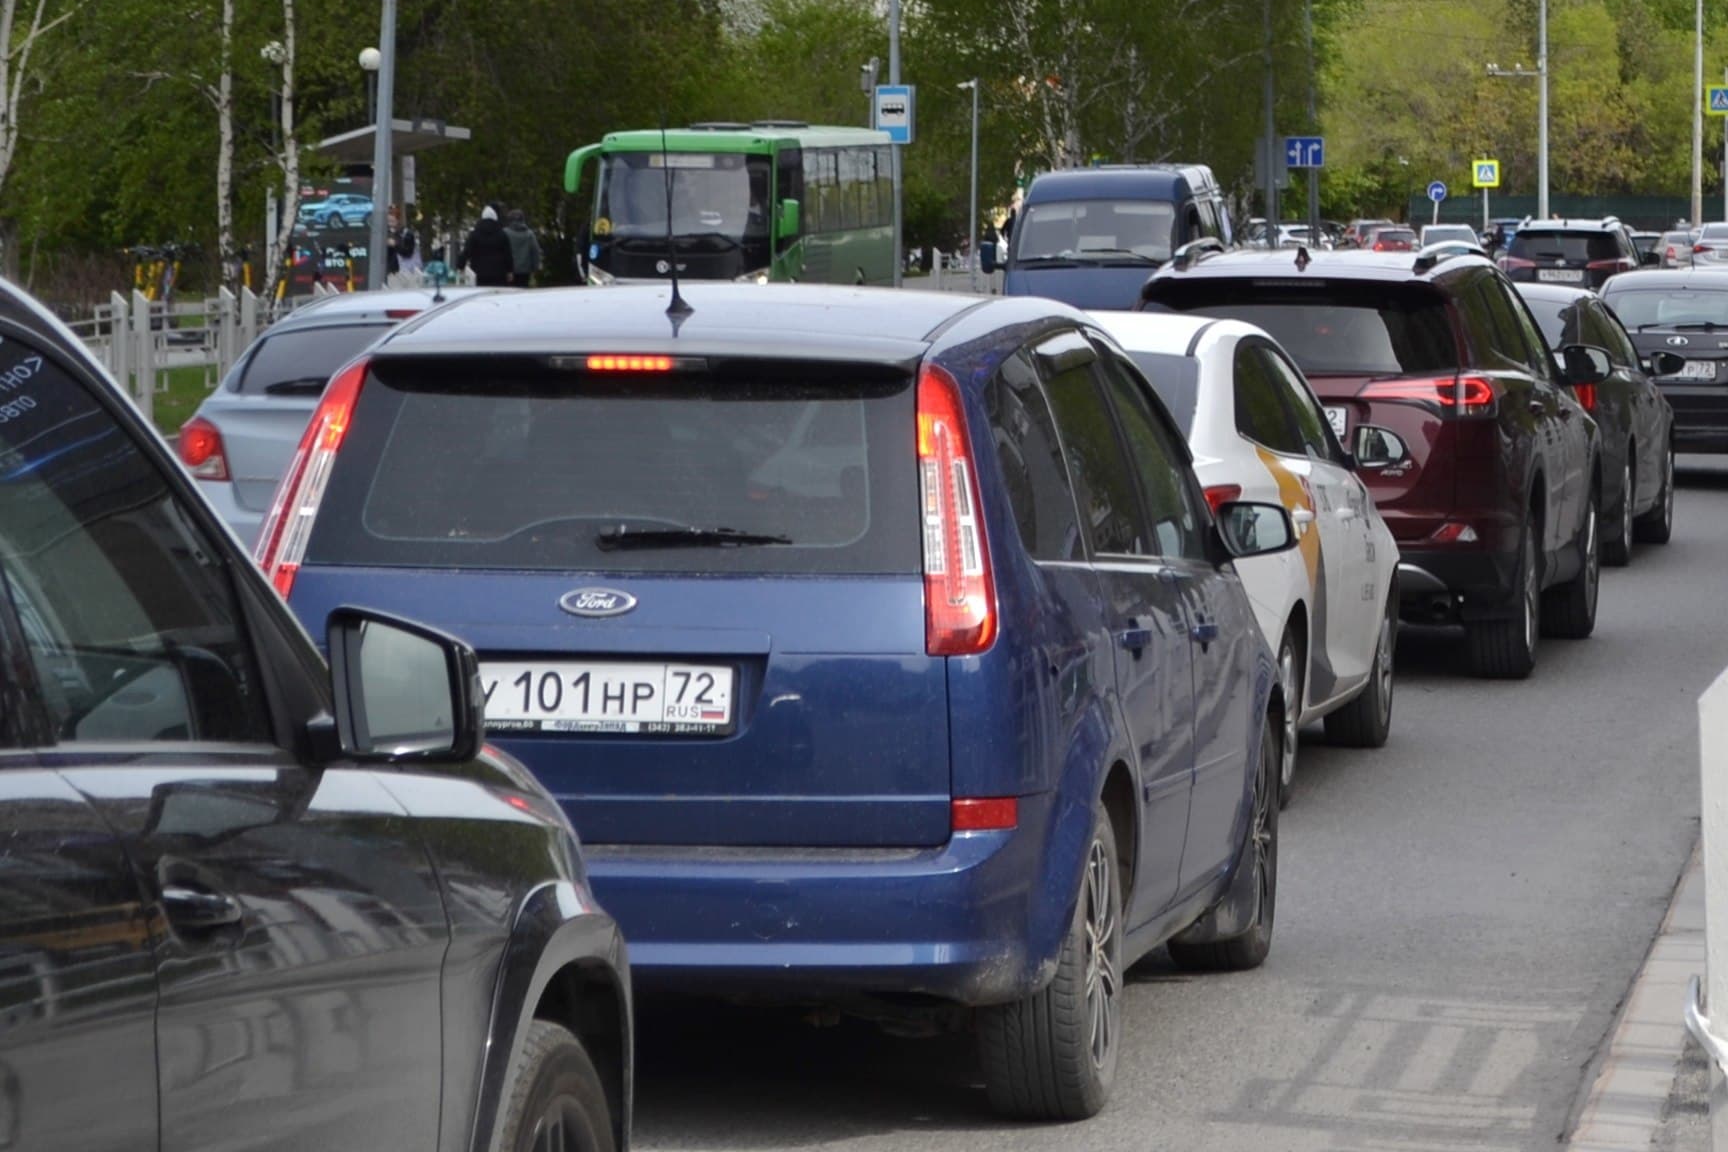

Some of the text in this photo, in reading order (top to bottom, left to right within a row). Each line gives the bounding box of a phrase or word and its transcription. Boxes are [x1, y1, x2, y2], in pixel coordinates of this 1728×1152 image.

[575, 592, 617, 609] Ford
[672, 671, 714, 704] 72
[665, 705, 699, 719] RUS
